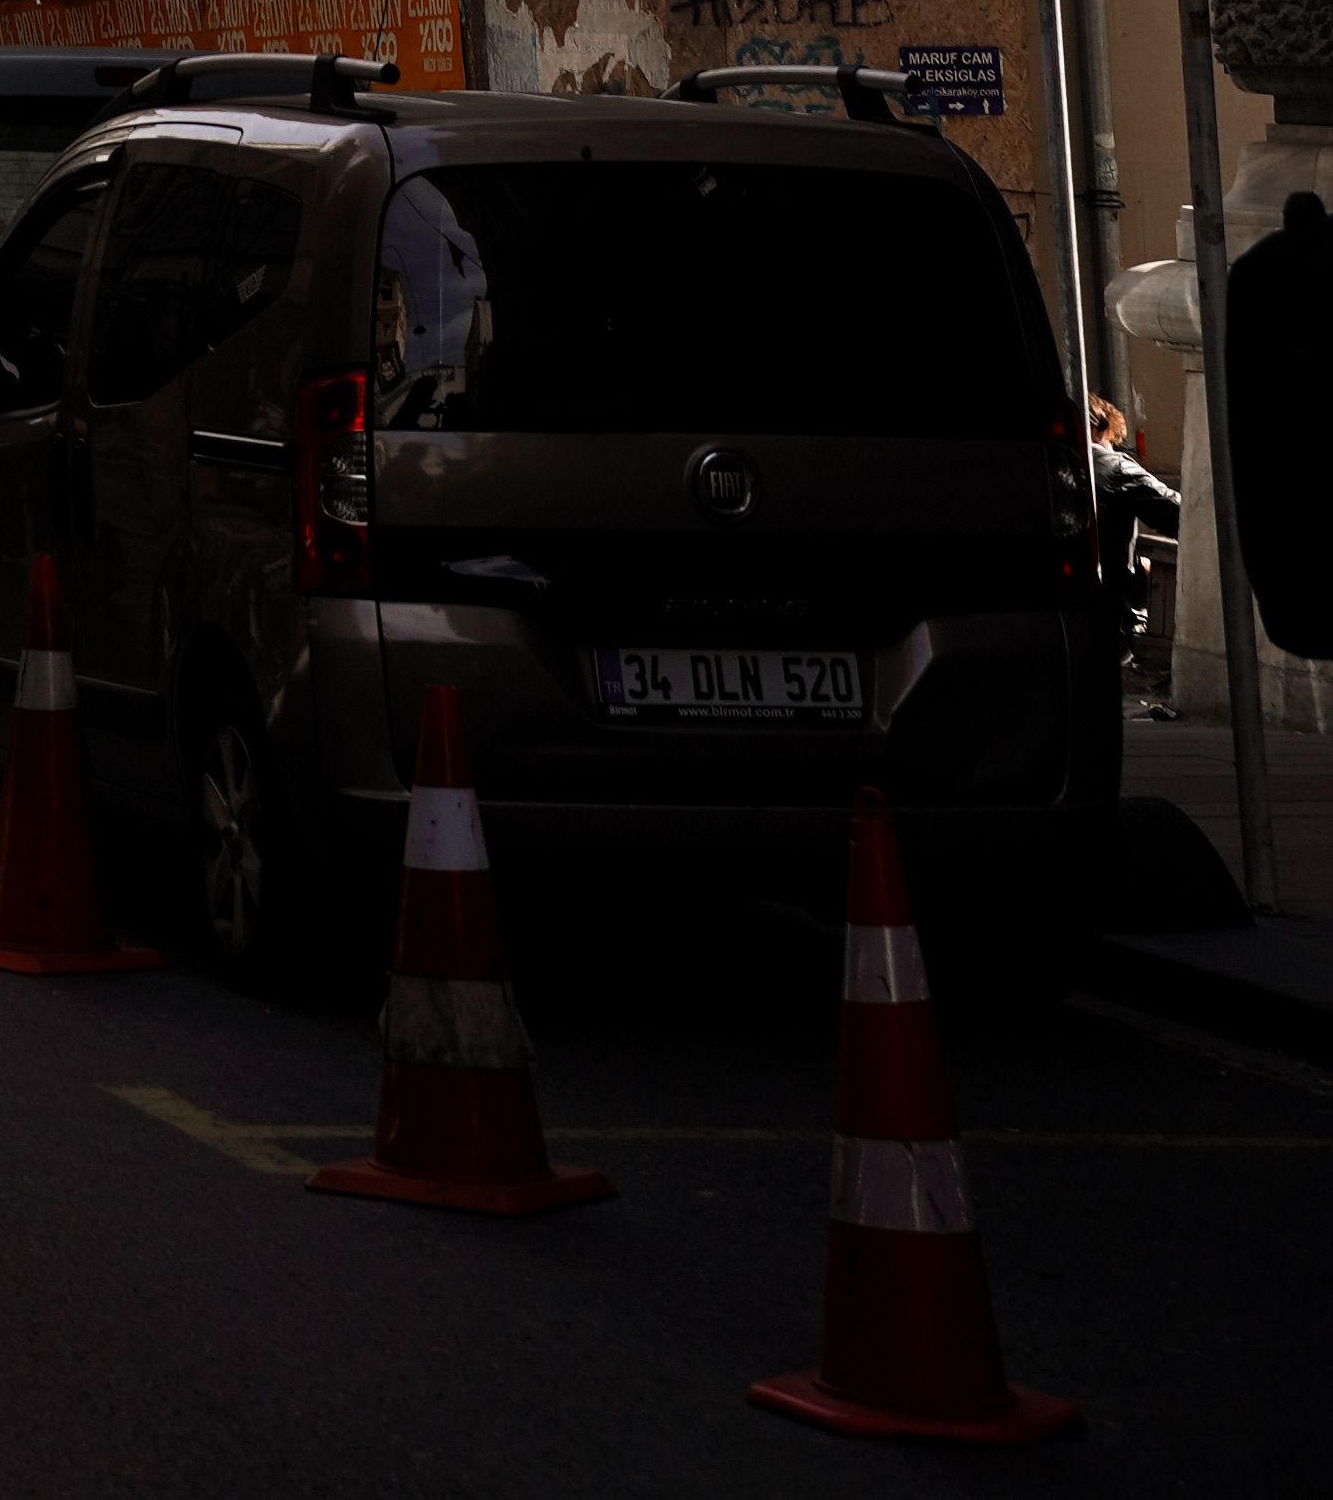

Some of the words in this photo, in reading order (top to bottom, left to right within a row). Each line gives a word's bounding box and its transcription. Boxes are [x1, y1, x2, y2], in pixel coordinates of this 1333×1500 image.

[908, 52, 958, 65] MARUF
[961, 52, 993, 65] CAM
[710, 470, 743, 499] FIAT
[624, 655, 671, 701] 34
[691, 655, 764, 701] DLN
[782, 657, 853, 702] 520
[605, 680, 622, 693] TR
[678, 705, 796, 718] www.birmot.com.tr
